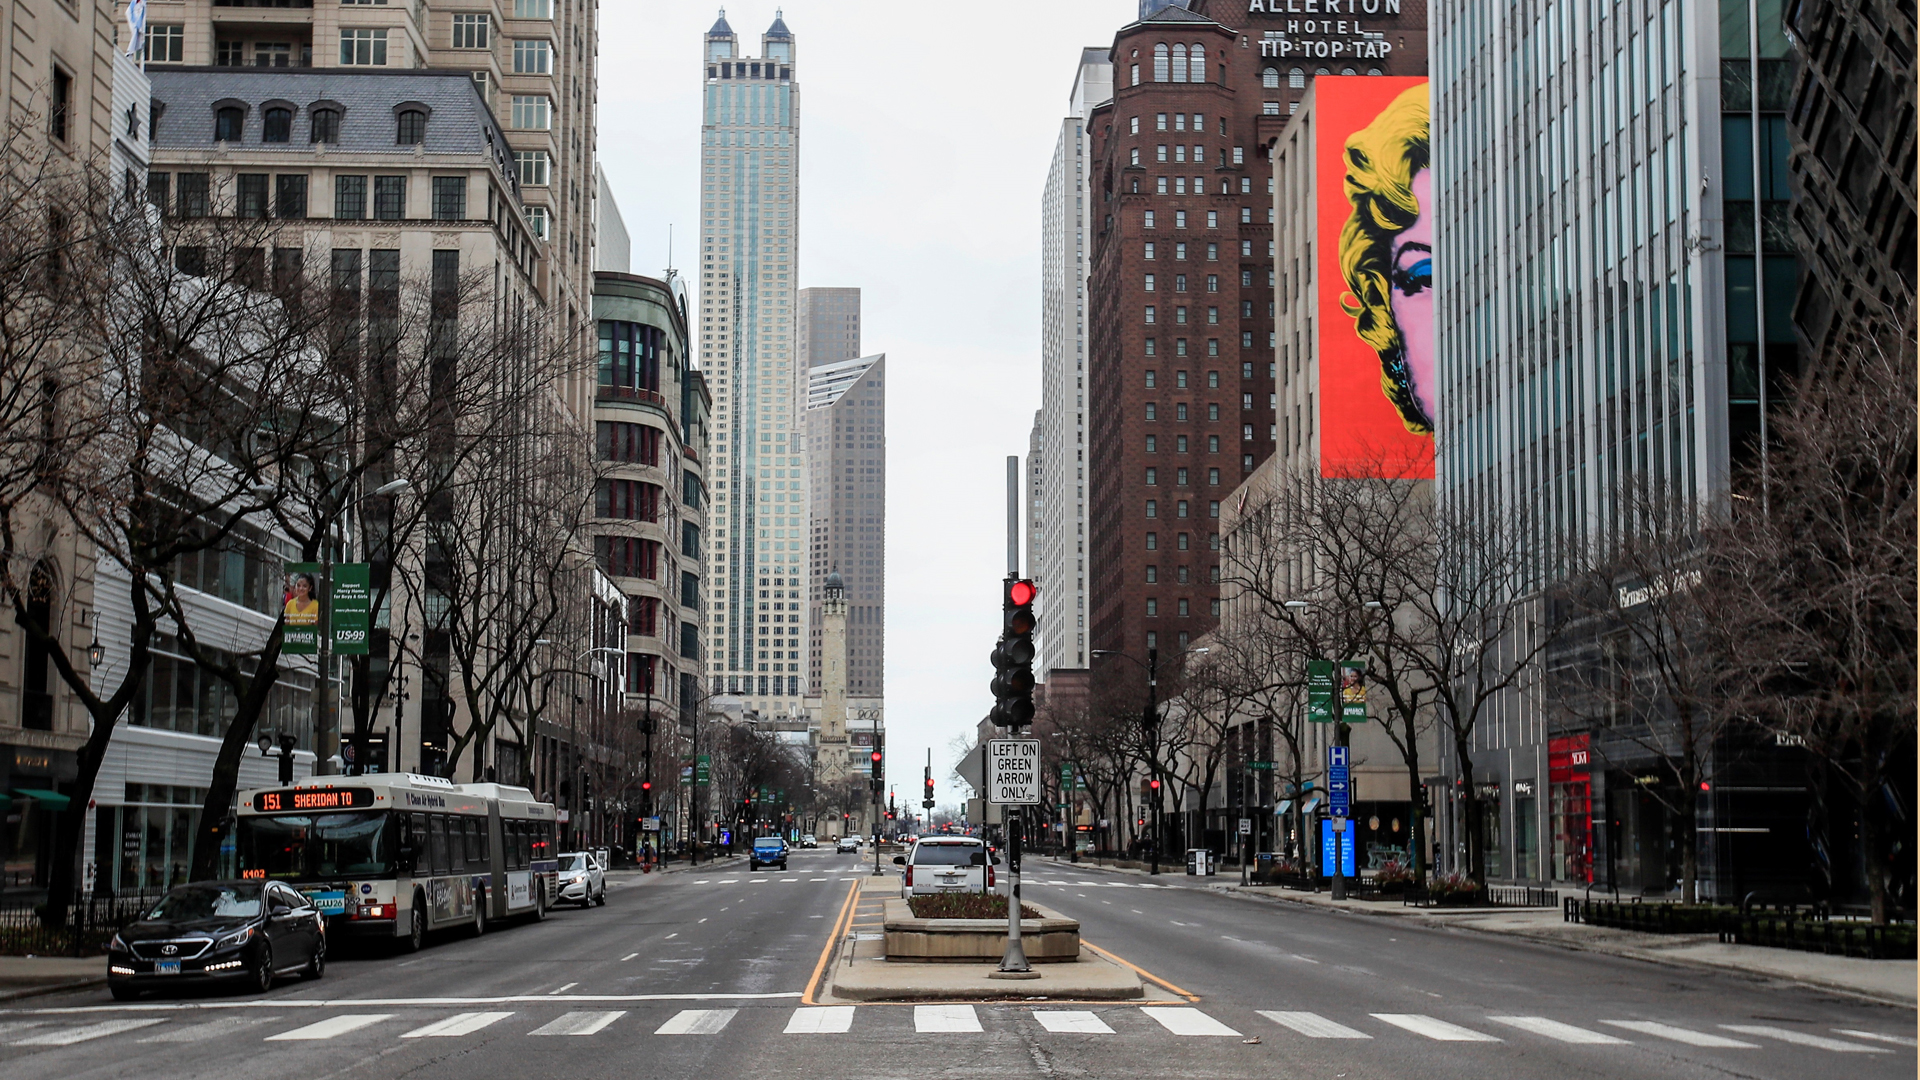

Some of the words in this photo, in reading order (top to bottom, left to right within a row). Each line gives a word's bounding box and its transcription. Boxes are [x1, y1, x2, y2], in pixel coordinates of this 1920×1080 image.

[1249, 0, 1401, 13] ALLERTON
[1287, 20, 1364, 34] HOTEL
[1258, 41, 1293, 57] TIP
[1302, 41, 1344, 58] TOP
[1352, 41, 1393, 58] TAP
[993, 743, 1018, 756] LEFT
[1022, 744, 1036, 756] ON
[1331, 748, 1346, 765] H
[997, 759, 1032, 770] GREEN
[996, 772, 1033, 785] ARROW
[411, 792, 422, 805] Clean
[1001, 787, 1027, 799] ONLY
[263, 794, 282, 810] 151
[294, 792, 338, 808] SHERIDAN
[340, 792, 352, 806] TO
[242, 869, 266, 879] K402
